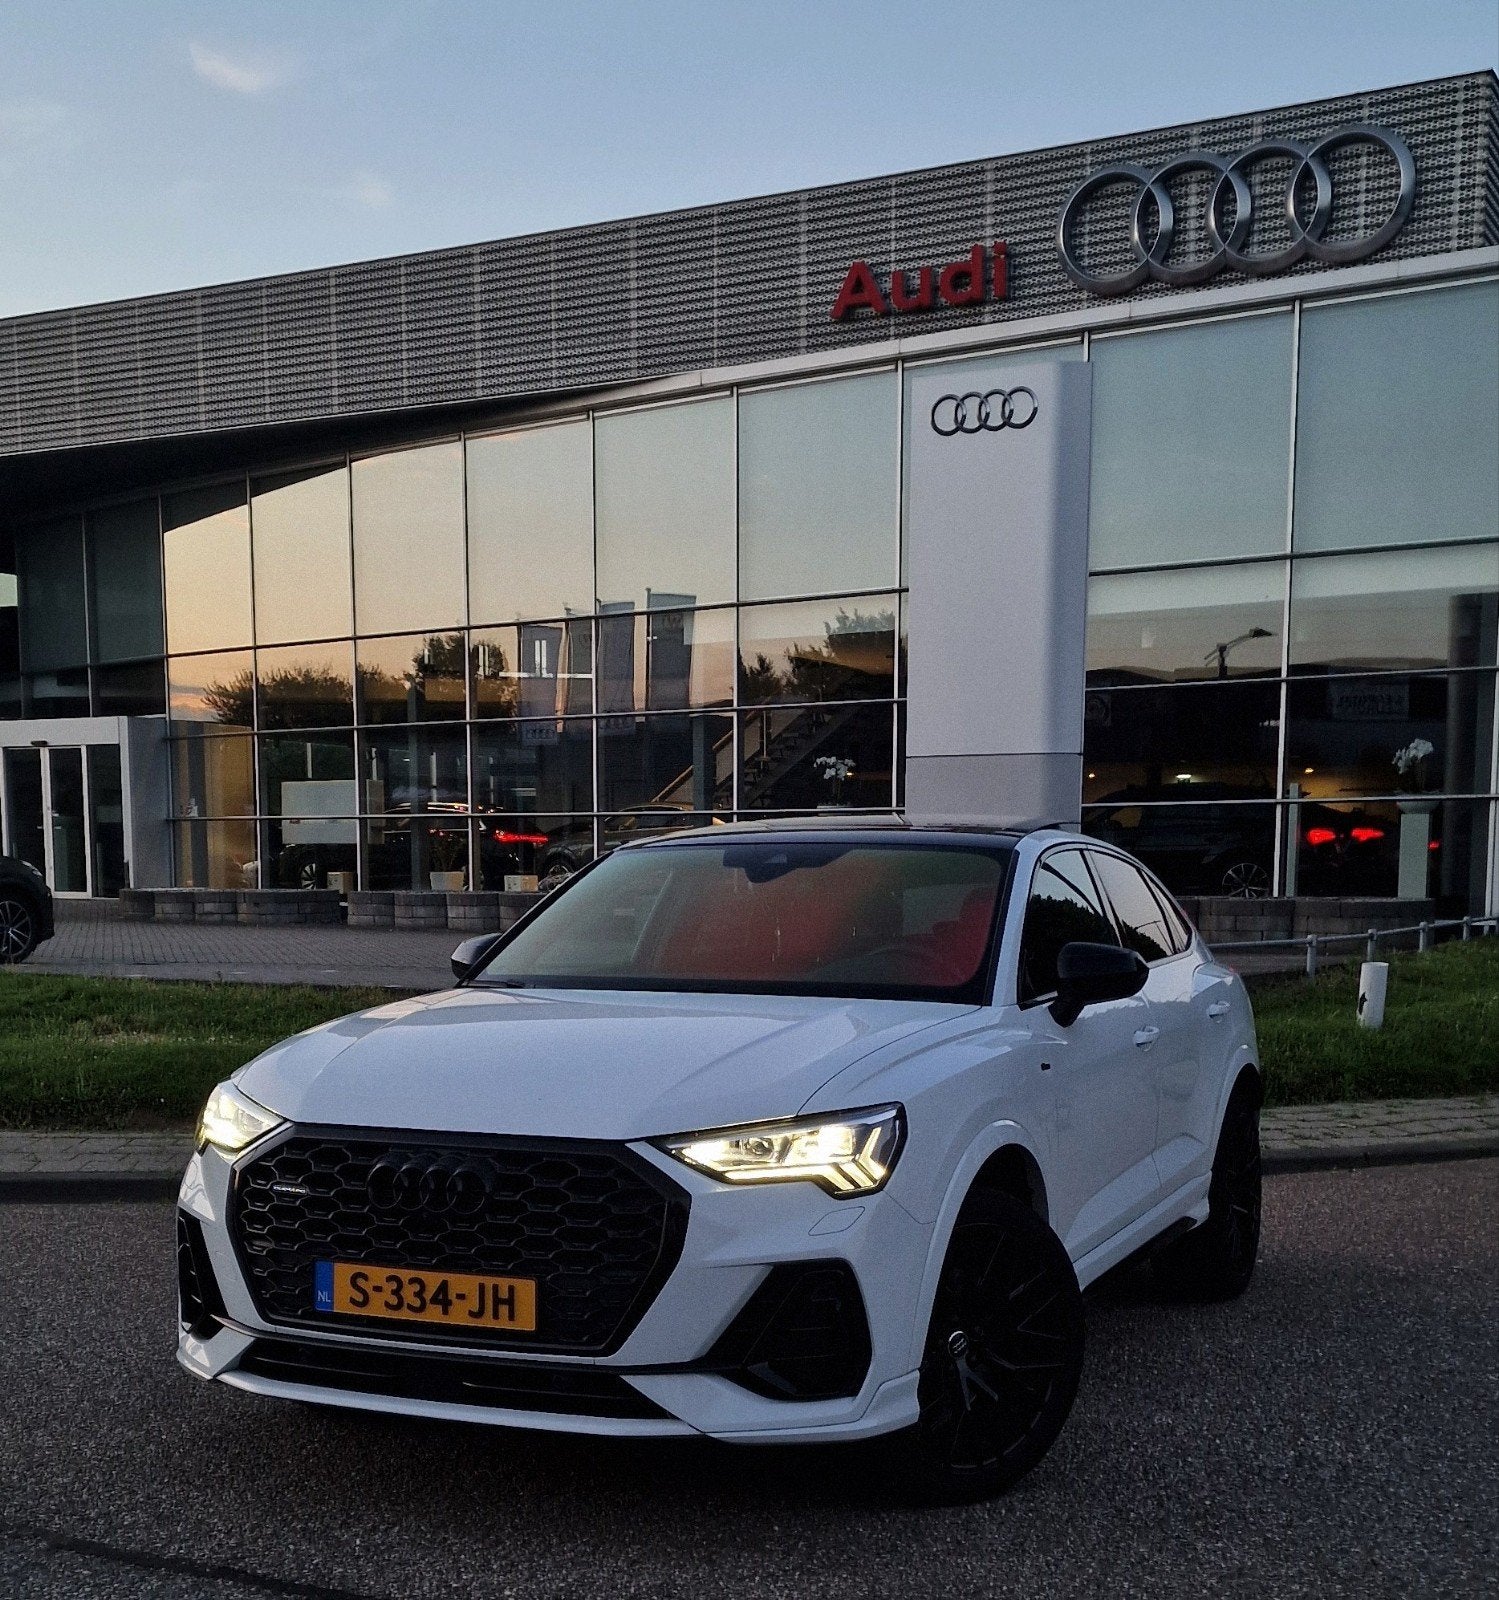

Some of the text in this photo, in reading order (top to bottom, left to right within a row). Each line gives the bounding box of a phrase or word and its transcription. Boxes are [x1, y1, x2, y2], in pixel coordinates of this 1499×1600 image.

[831, 241, 1007, 319] Audi
[317, 1290, 331, 1303] NL
[349, 1271, 515, 1321] S-334-JH
